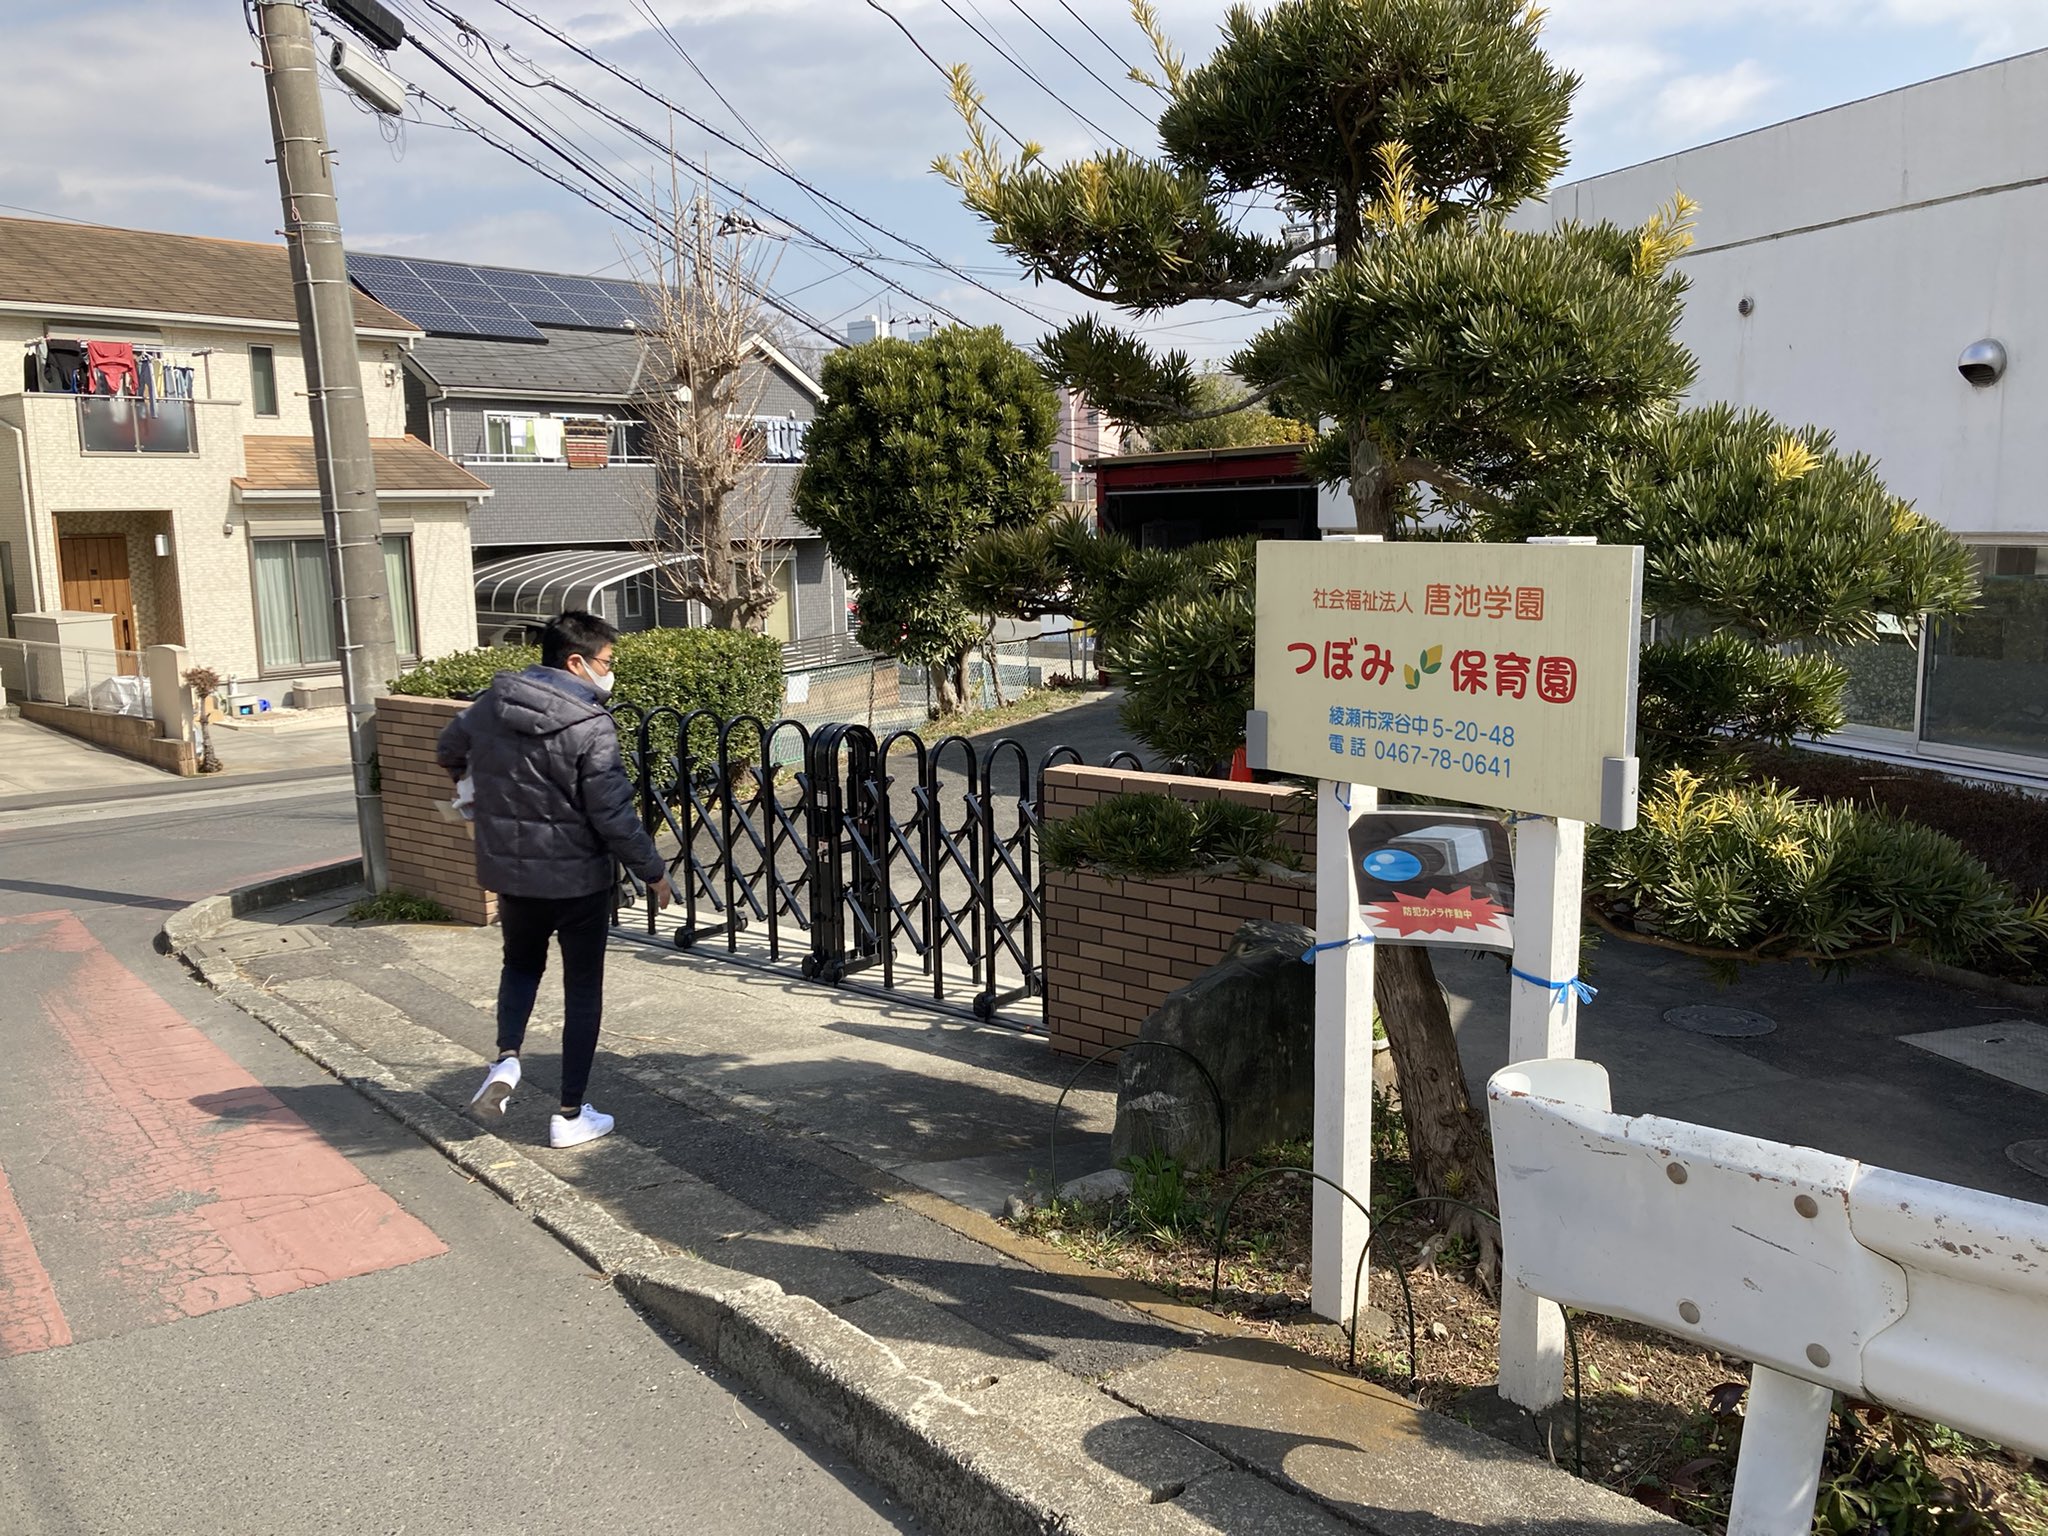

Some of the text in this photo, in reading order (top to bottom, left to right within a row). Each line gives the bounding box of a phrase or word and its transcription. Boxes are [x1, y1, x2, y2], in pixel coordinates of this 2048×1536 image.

[1312, 582, 1544, 621] 社会福祉法人 唐池学園
[1286, 636, 1578, 705] つぼみ 保育園
[1374, 739, 1512, 779] 0467-78-0641
[1402, 905, 1473, 920] 防犯カメラ作動中
